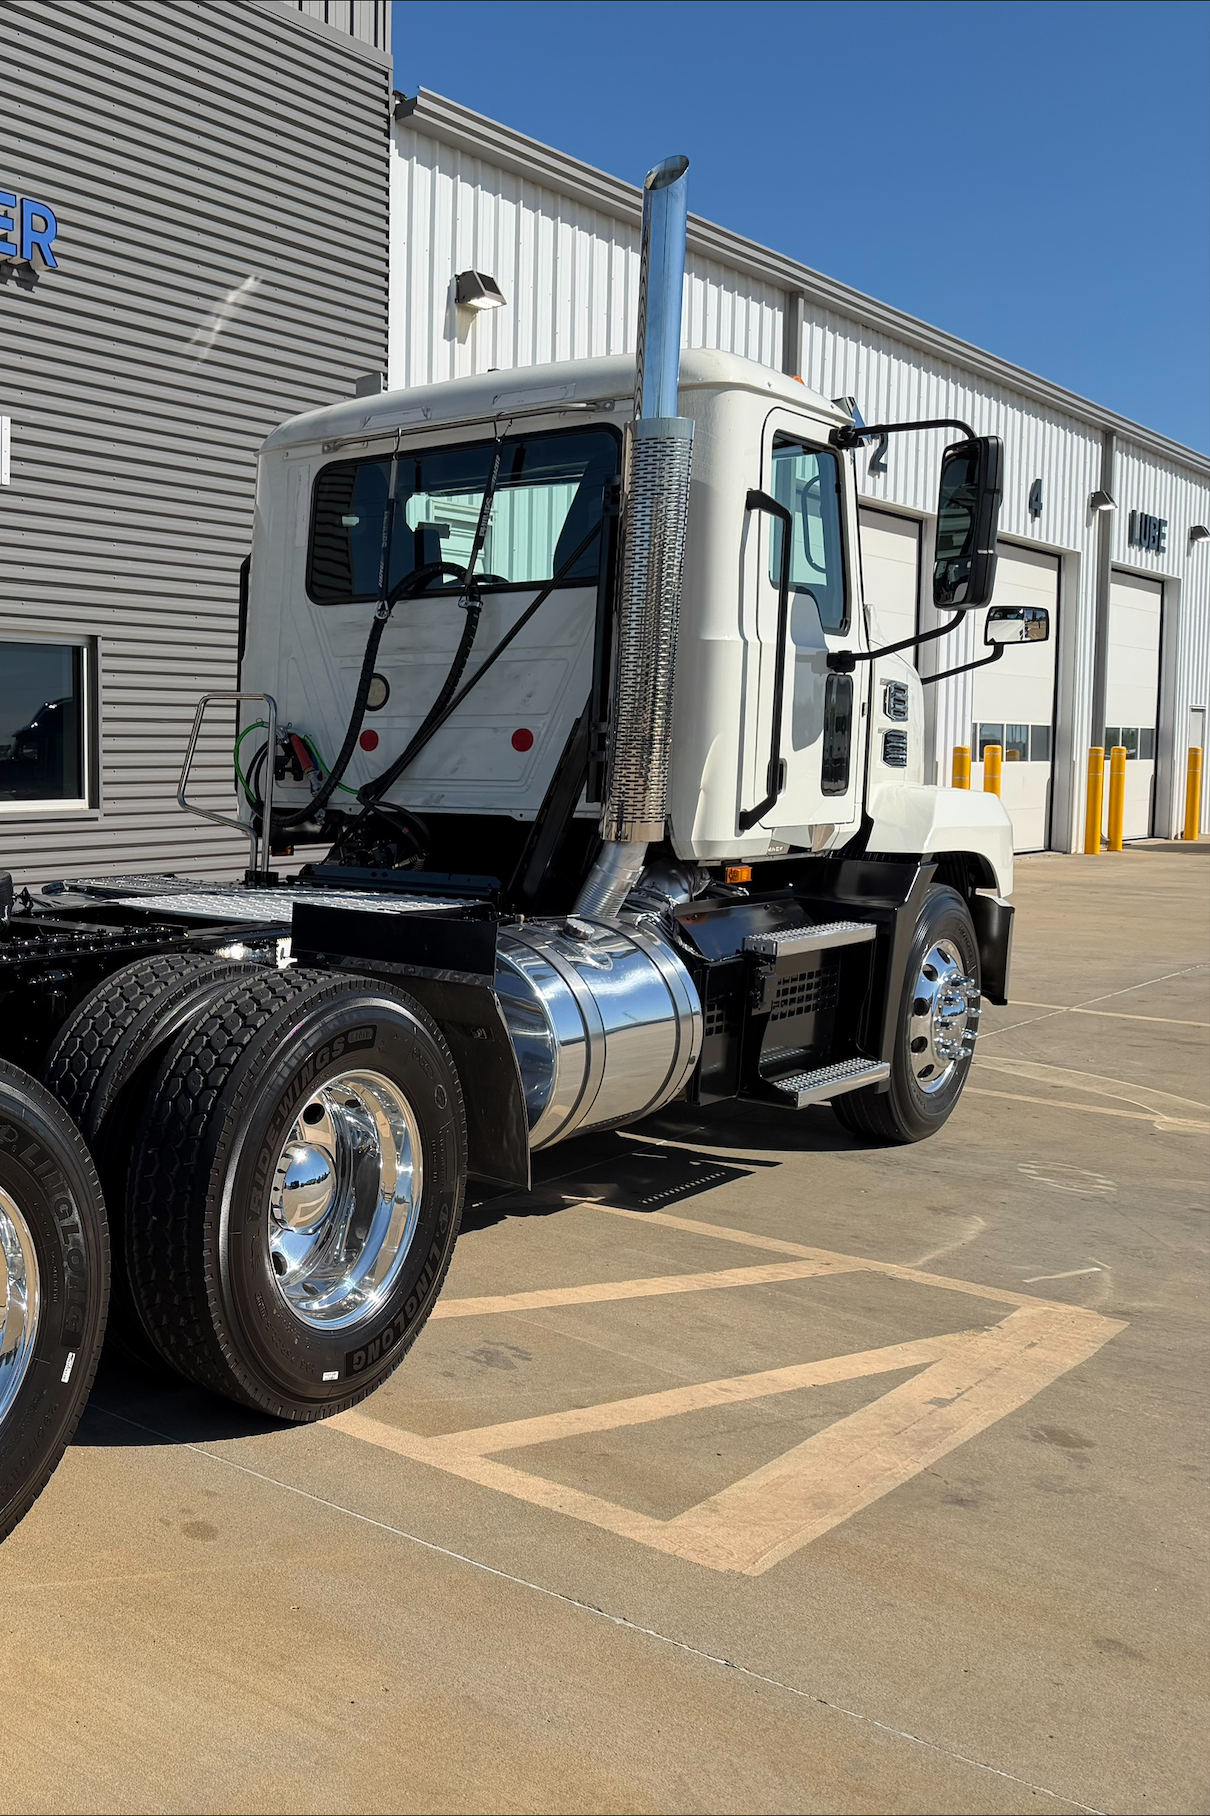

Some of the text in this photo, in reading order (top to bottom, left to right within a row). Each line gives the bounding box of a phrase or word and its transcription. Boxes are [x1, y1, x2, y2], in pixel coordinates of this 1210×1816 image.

[870, 424, 888, 473] 2
[1029, 478, 1043, 518] 4
[1129, 509, 1168, 554] LUBE
[249, 1036, 345, 1215] RIDE-WINGS
[19, 1142, 85, 1333] LINGLONG
[353, 1241, 442, 1371] LINGLONG
